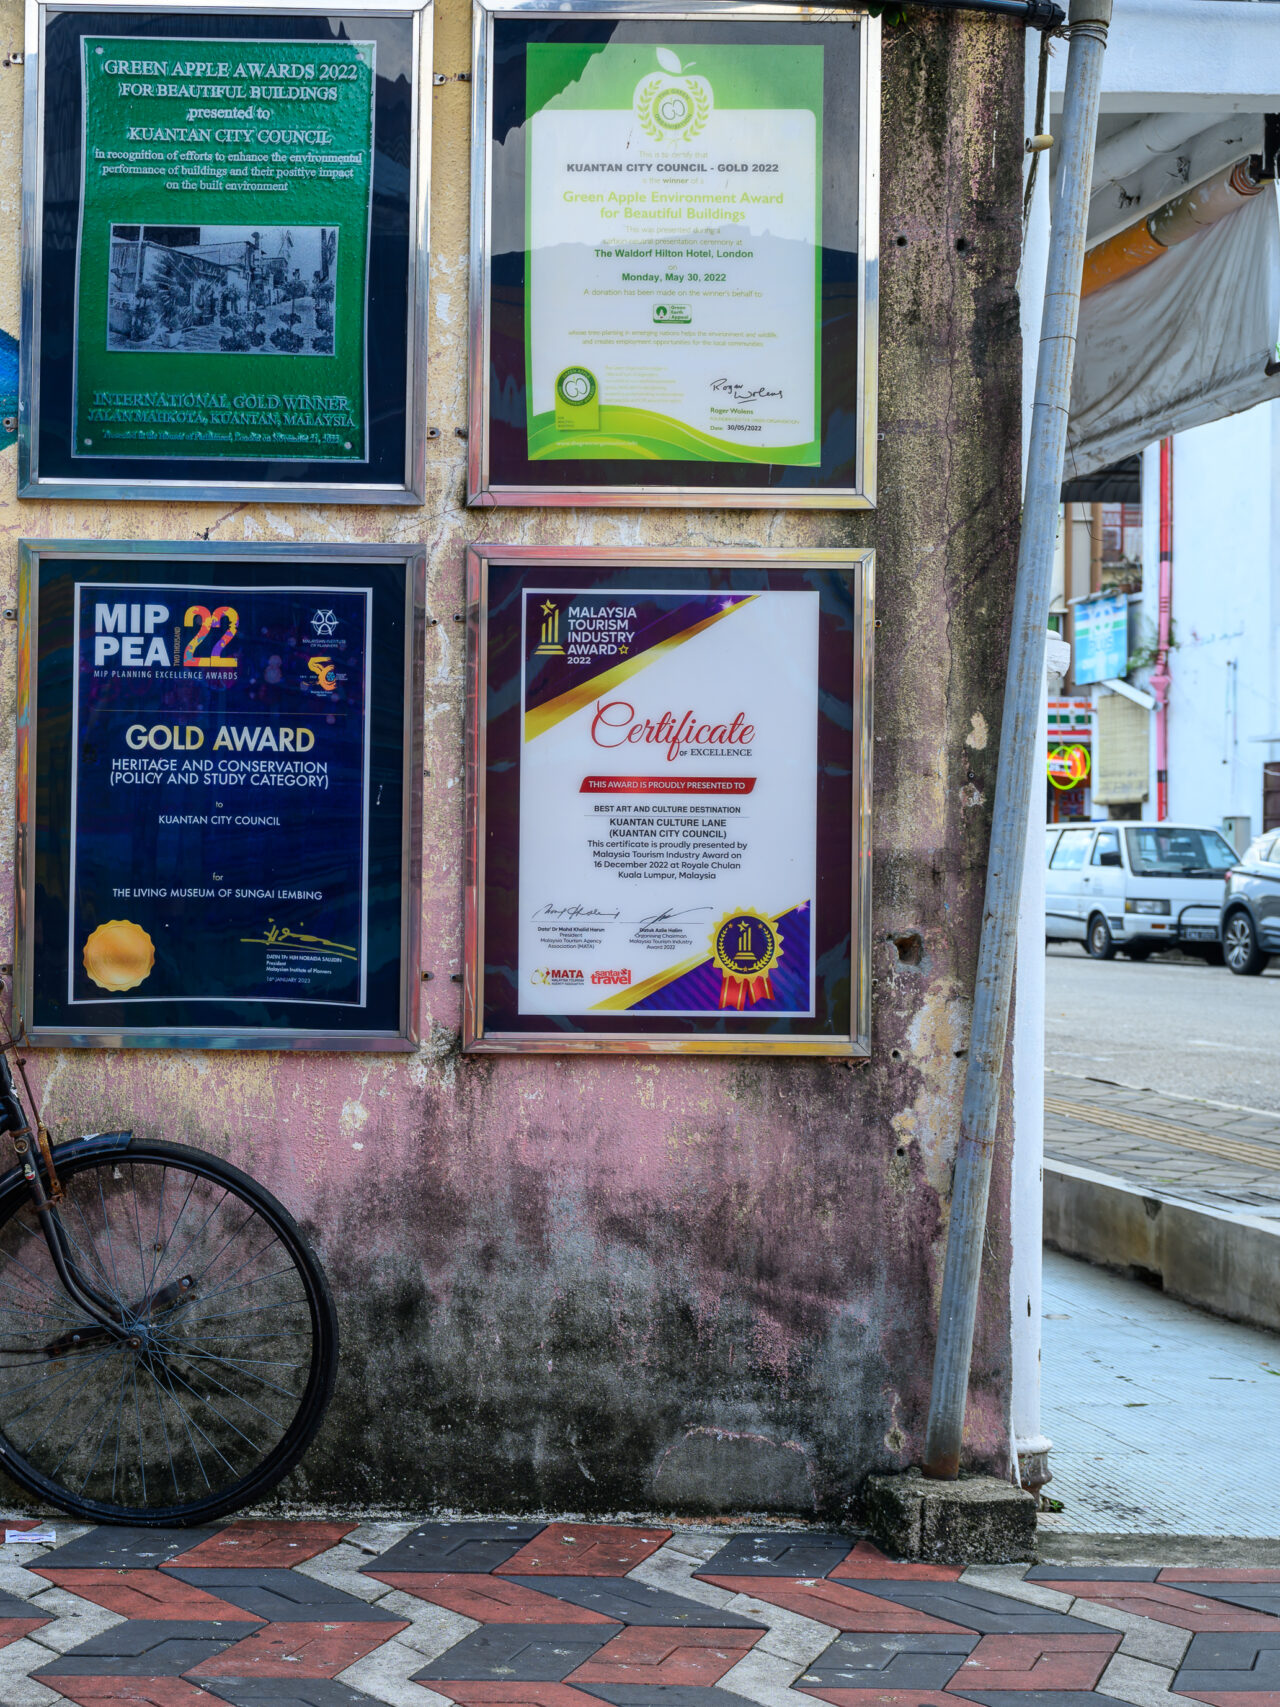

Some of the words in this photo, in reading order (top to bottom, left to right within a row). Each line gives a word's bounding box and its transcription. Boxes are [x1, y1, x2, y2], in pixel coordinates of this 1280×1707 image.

[105, 60, 168, 76] GREEN
[173, 62, 229, 78] APPLE
[233, 63, 315, 78] AWARDS
[320, 65, 357, 80] 2022
[121, 83, 154, 97] FOR
[157, 85, 246, 99] BEAUTIFUL
[249, 86, 337, 100] BUILDINGS
[187, 107, 253, 121] presented
[256, 108, 270, 119] to
[129, 128, 212, 143] KUANTAN
[215, 129, 253, 143] CITY
[257, 130, 332, 144] COUNCIL
[567, 163, 623, 172] KUANTAN
[626, 163, 652, 172] CITY
[656, 163, 707, 172] COUNCIL
[717, 163, 748, 172] GOLD
[752, 164, 779, 172] 2022
[166, 181, 179, 189] on
[182, 181, 197, 190] the
[200, 181, 222, 191] built
[225, 181, 288, 191] environment
[563, 191, 603, 203] Green
[608, 192, 647, 205] Apple
[651, 192, 736, 204] Environment
[739, 192, 783, 204] Award
[600, 208, 620, 219] for
[624, 208, 681, 219] Beautiful
[686, 208, 745, 223] Buildings
[595, 249, 611, 257] The
[615, 249, 652, 258] Waldorf
[655, 249, 682, 258] Hilton
[686, 249, 713, 259] Hotel,
[717, 249, 753, 258] London
[622, 273, 662, 283] Monday,
[665, 273, 684, 283] May
[687, 273, 701, 283] 30,
[710, 407, 727, 415] Roger
[568, 607, 637, 618] MALAYSIA
[95, 603, 169, 633] MIP
[568, 620, 628, 630] TOURISM
[184, 605, 239, 667] 22
[568, 632, 635, 642] INDUSTRY
[95, 637, 170, 666] PEA
[567, 645, 617, 655] AWARD
[112, 670, 152, 678] PLANNING
[156, 671, 203, 679] EXCELLENCE
[206, 671, 237, 680] AWARDS
[591, 701, 755, 761] Certificate
[126, 725, 203, 750] GOLD
[213, 726, 314, 752] AWARD
[112, 759, 177, 771] HERITAGE
[182, 760, 213, 771] AND
[219, 761, 327, 773] CONSERVATION
[110, 772, 163, 786] (POLICY
[167, 773, 199, 785] AND
[203, 773, 246, 786] STUDY
[250, 774, 329, 790] CATEGORY)
[633, 805, 650, 813] AND
[159, 816, 207, 824] KUANTAN
[211, 816, 232, 825] CITY
[235, 816, 280, 826] COUNCIL
[610, 829, 657, 838] (KUANTAN
[659, 830, 680, 838] CITY
[682, 830, 727, 839] COUNCIL)
[659, 841, 691, 850] proudly
[693, 841, 734, 850] presented
[737, 842, 747, 850] by
[593, 851, 630, 860] Malaysia
[666, 851, 700, 860] Industry
[682, 862, 708, 870] Royale
[643, 872, 676, 880] Lumpur,
[679, 872, 716, 880] Malaysia
[113, 888, 131, 897] THE
[134, 889, 167, 898] LIVING
[170, 889, 215, 898] MUSEUM
[218, 889, 232, 898] OF
[235, 889, 275, 899] SUNGAI
[278, 890, 322, 900] LEMBING
[552, 970, 583, 978] MATA
[591, 969, 631, 984] travel
